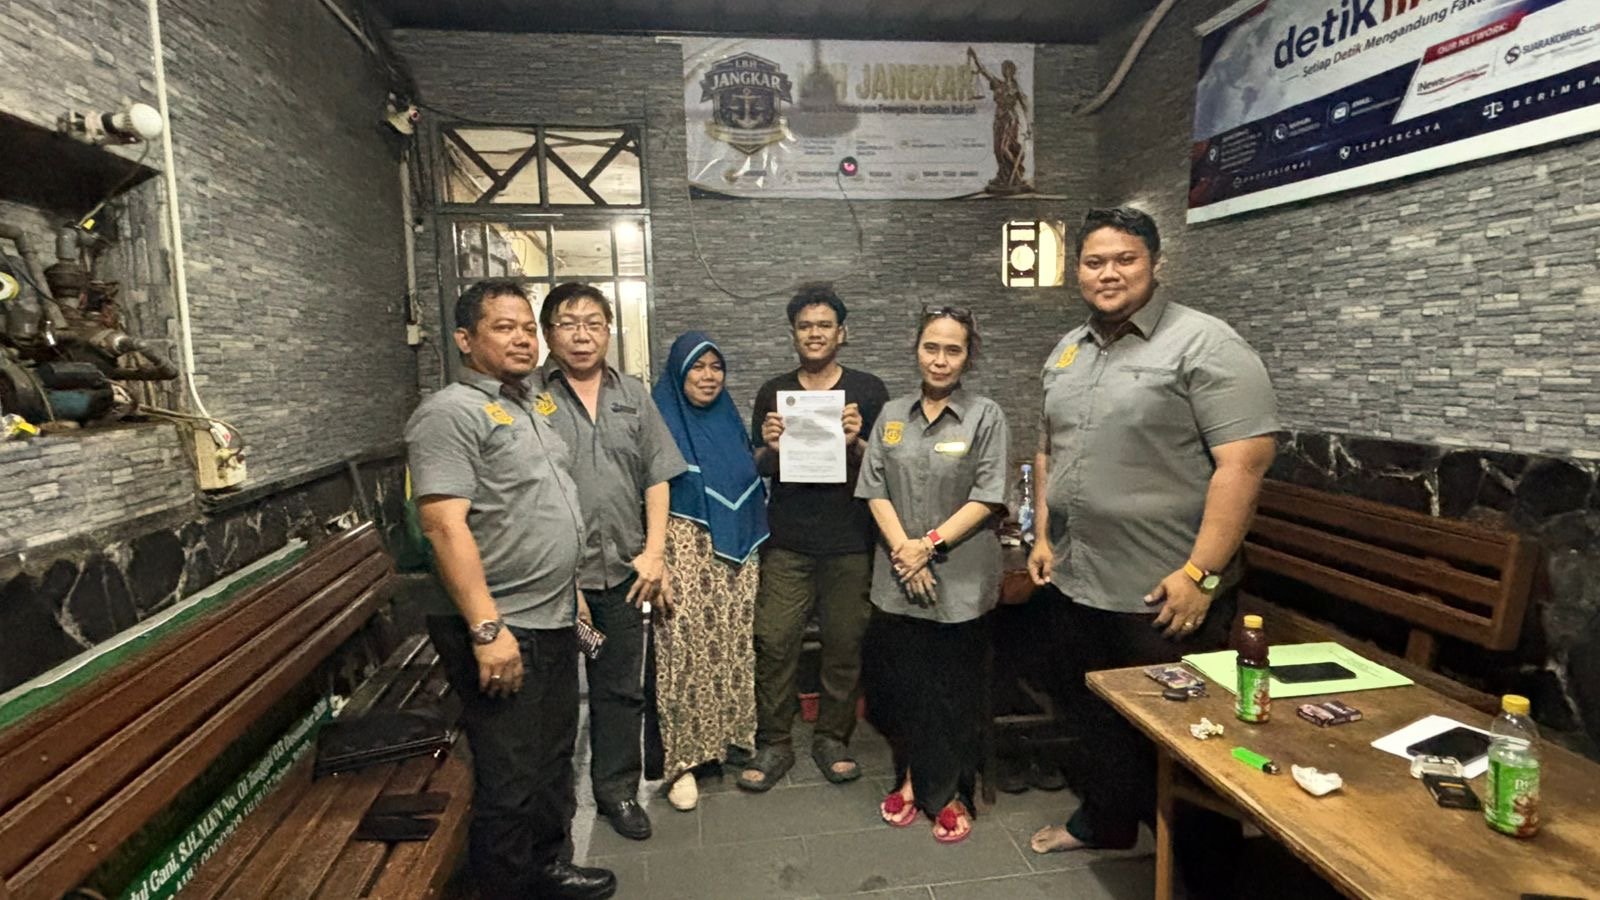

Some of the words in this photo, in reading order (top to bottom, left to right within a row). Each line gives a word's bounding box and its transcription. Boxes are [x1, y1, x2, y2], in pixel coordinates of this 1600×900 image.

[1303, 58, 1331, 77] Setiap
[1333, 43, 1362, 64] Detik
[1364, 8, 1448, 50] Mengandung
[1437, 42, 1457, 55] OUR
[711, 71, 782, 90] JANGKAR
[855, 62, 975, 101] JANGKAR
[1512, 78, 1600, 109] BERIMBA
[1354, 121, 1441, 152] TERPERCAYA
[149, 852, 180, 892] Gani,
